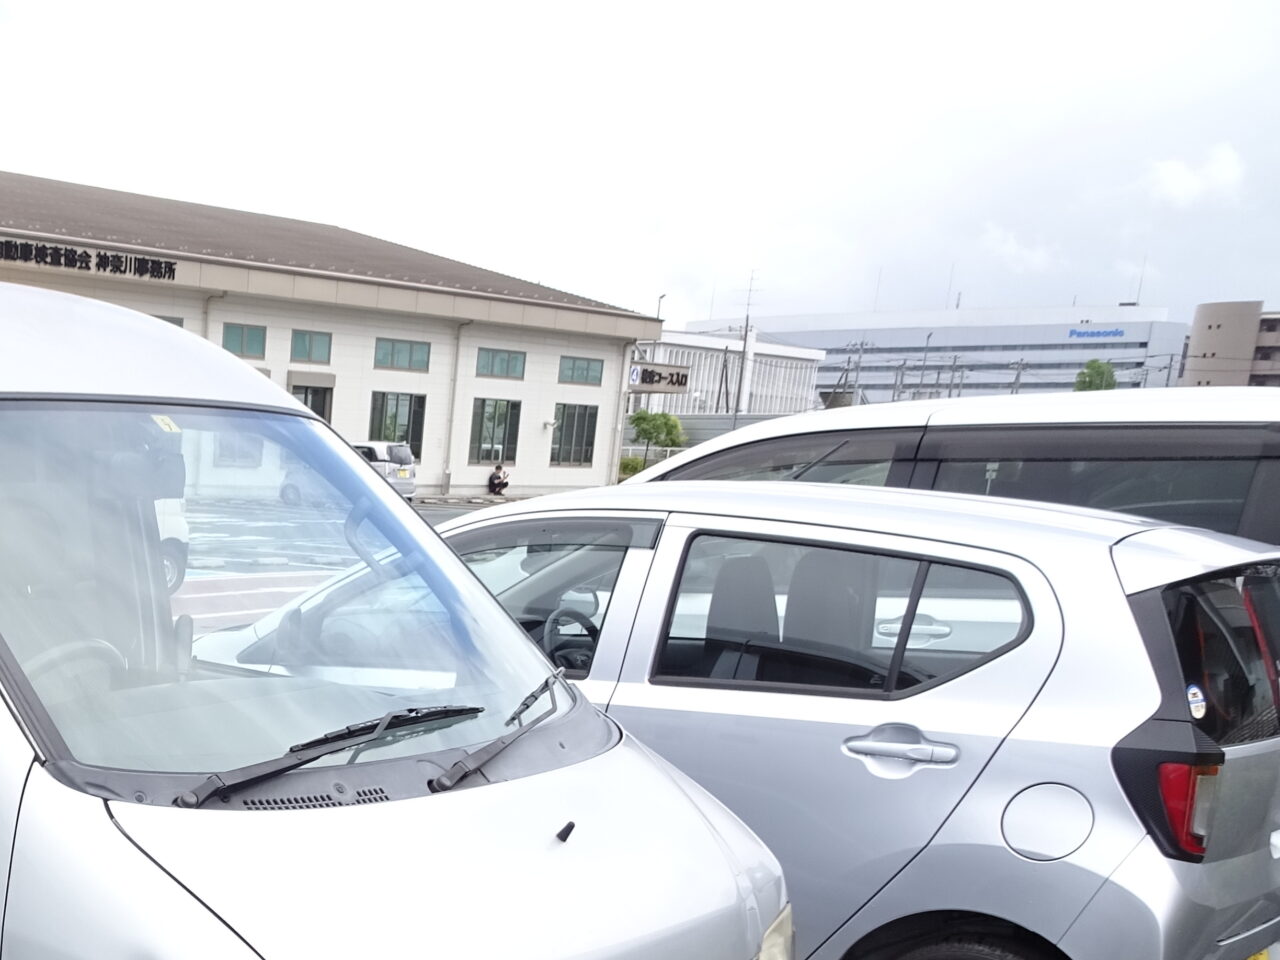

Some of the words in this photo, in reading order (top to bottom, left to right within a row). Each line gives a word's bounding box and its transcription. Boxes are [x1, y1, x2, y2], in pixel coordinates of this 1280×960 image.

[95, 251, 177, 281] 神奈川事務所
[1069, 329, 1124, 338] Panasonic
